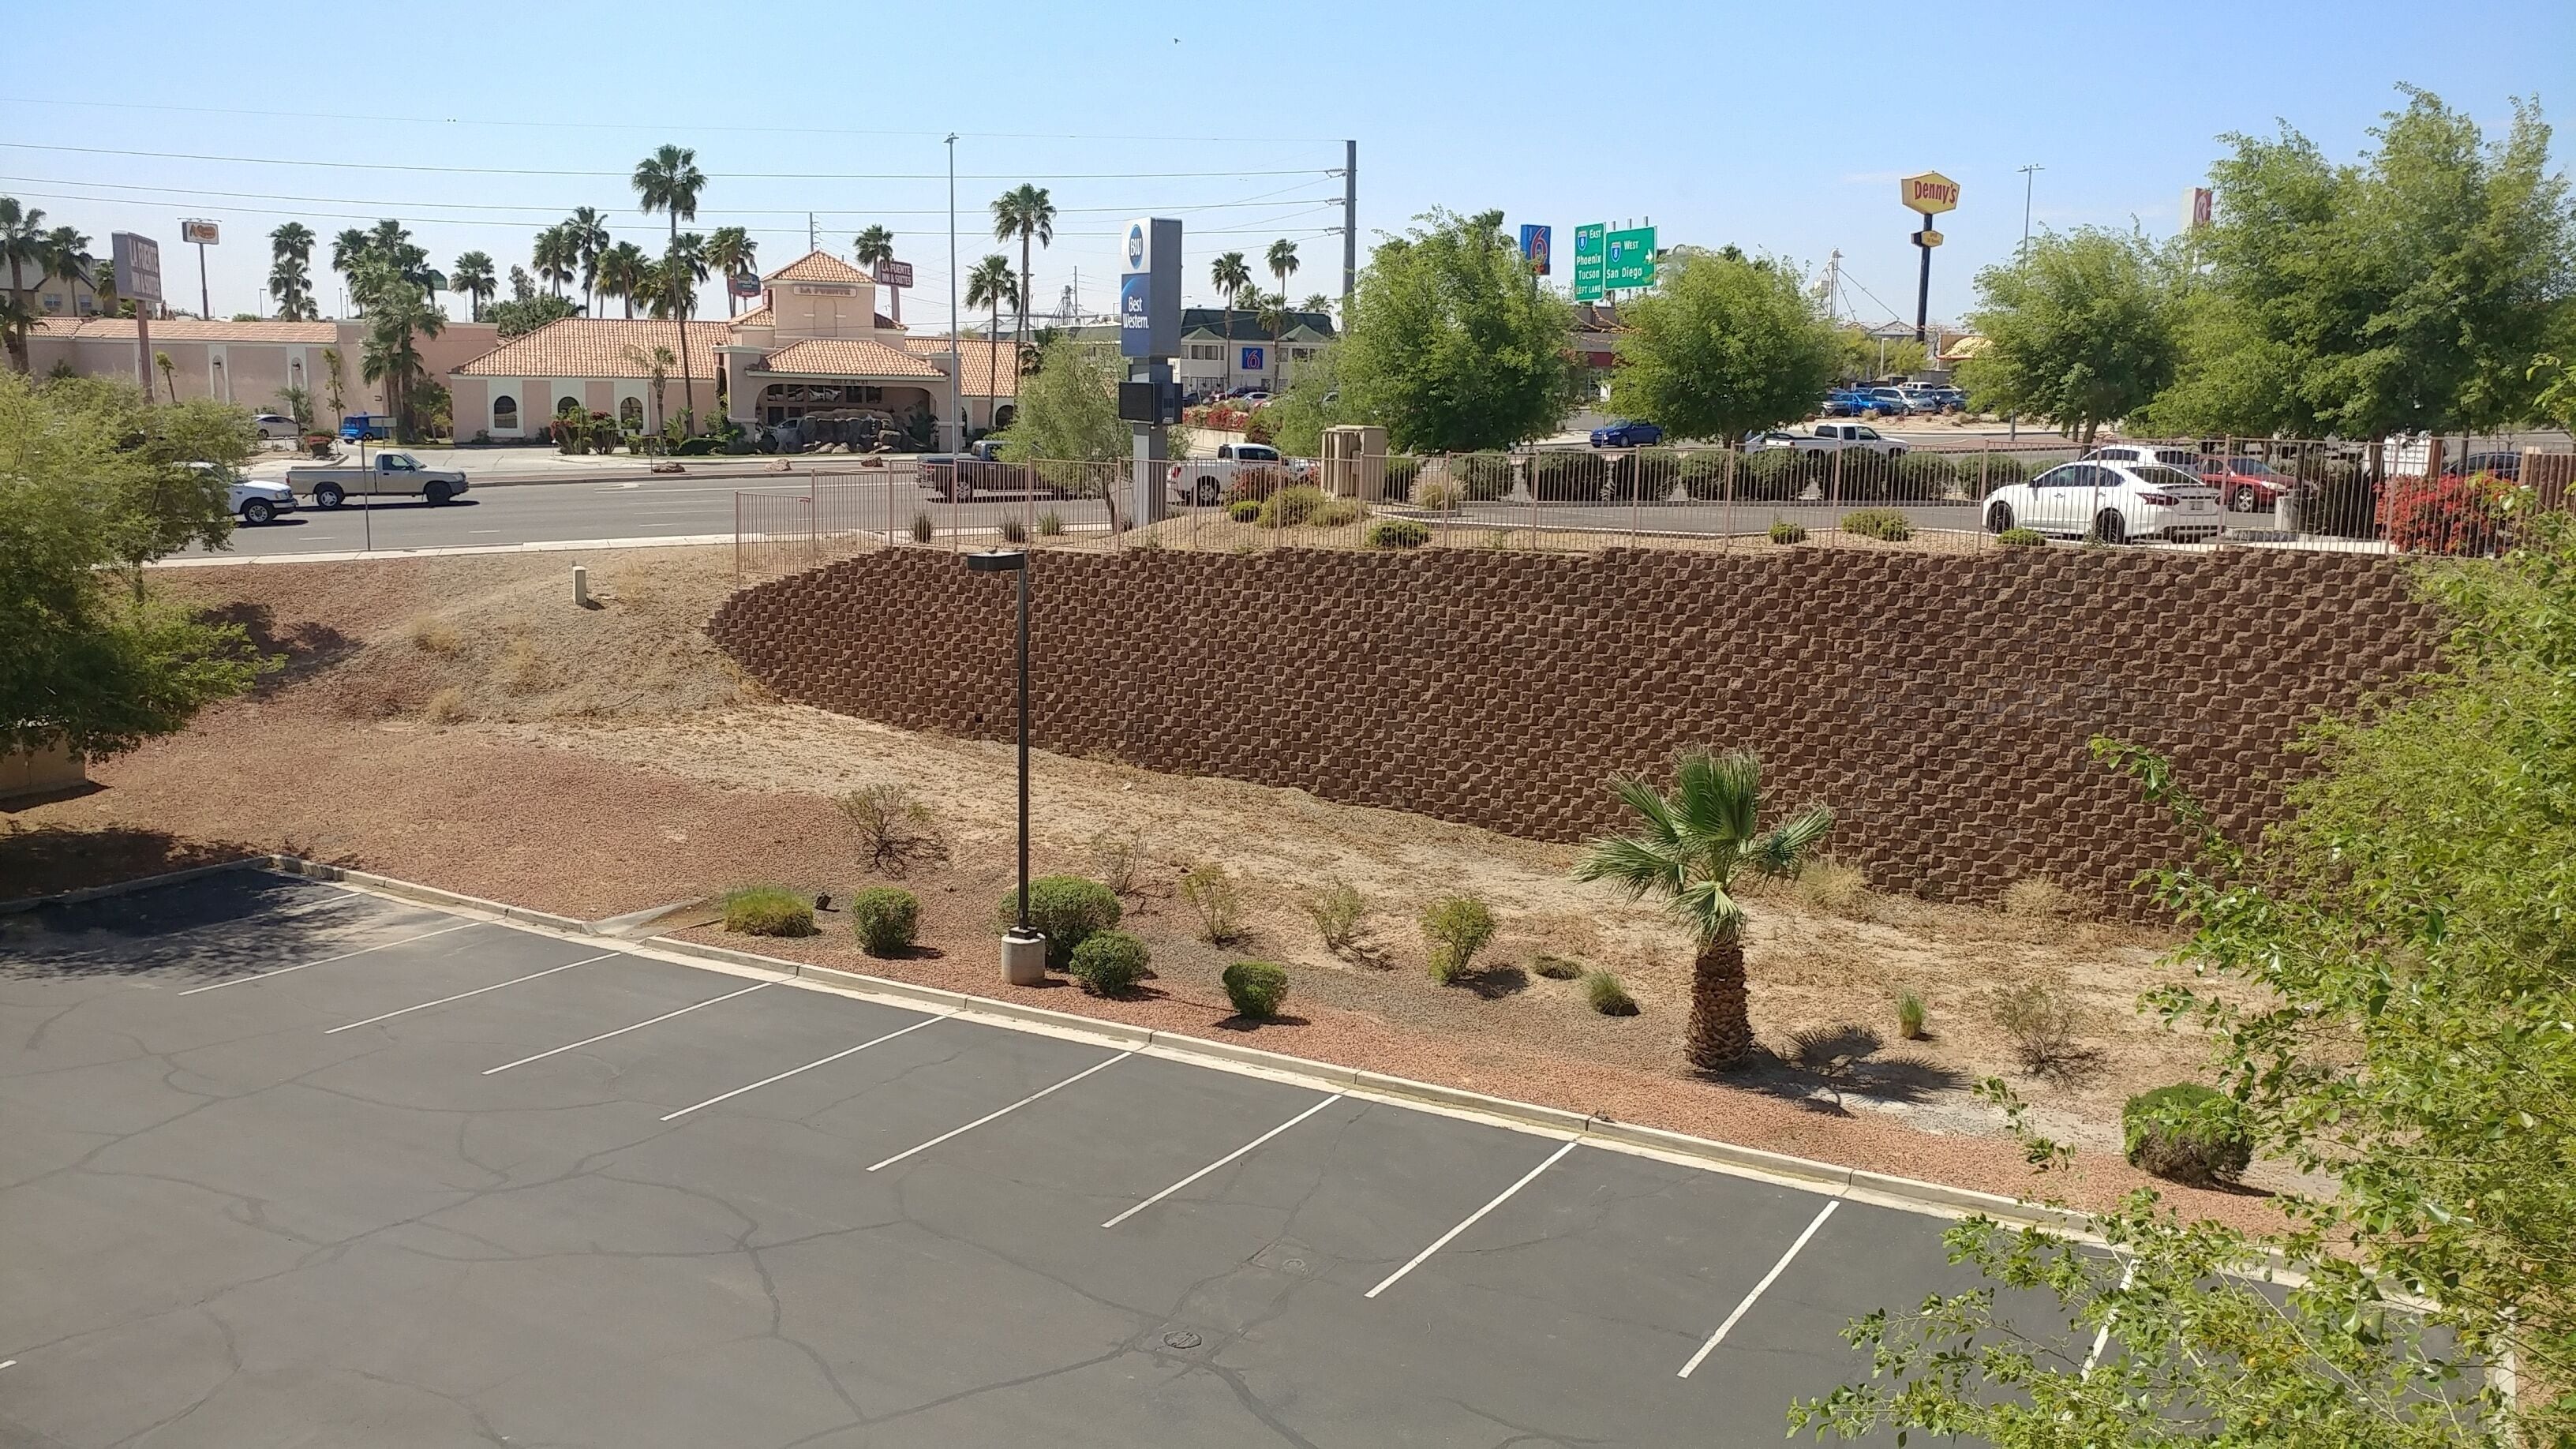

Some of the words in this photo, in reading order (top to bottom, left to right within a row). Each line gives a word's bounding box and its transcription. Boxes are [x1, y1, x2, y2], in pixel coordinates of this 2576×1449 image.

[1915, 181, 1956, 204] Denny's
[1589, 229, 1601, 239] EAST
[1130, 238, 1142, 256] BW
[1530, 227, 1548, 264] 6
[1581, 238, 1585, 247] 8
[1624, 240, 1638, 250] WEST
[1577, 253, 1601, 266] Phoenix
[1614, 249, 1618, 258] 8
[890, 263, 911, 275] FUENTE
[1578, 269, 1600, 280] Tucson
[1606, 268, 1619, 279] San
[1622, 266, 1642, 279] Diego
[895, 274, 911, 286] SUITES
[1589, 284, 1601, 294] LANE
[1128, 296, 1143, 312] Best
[1247, 350, 1260, 369] 6
